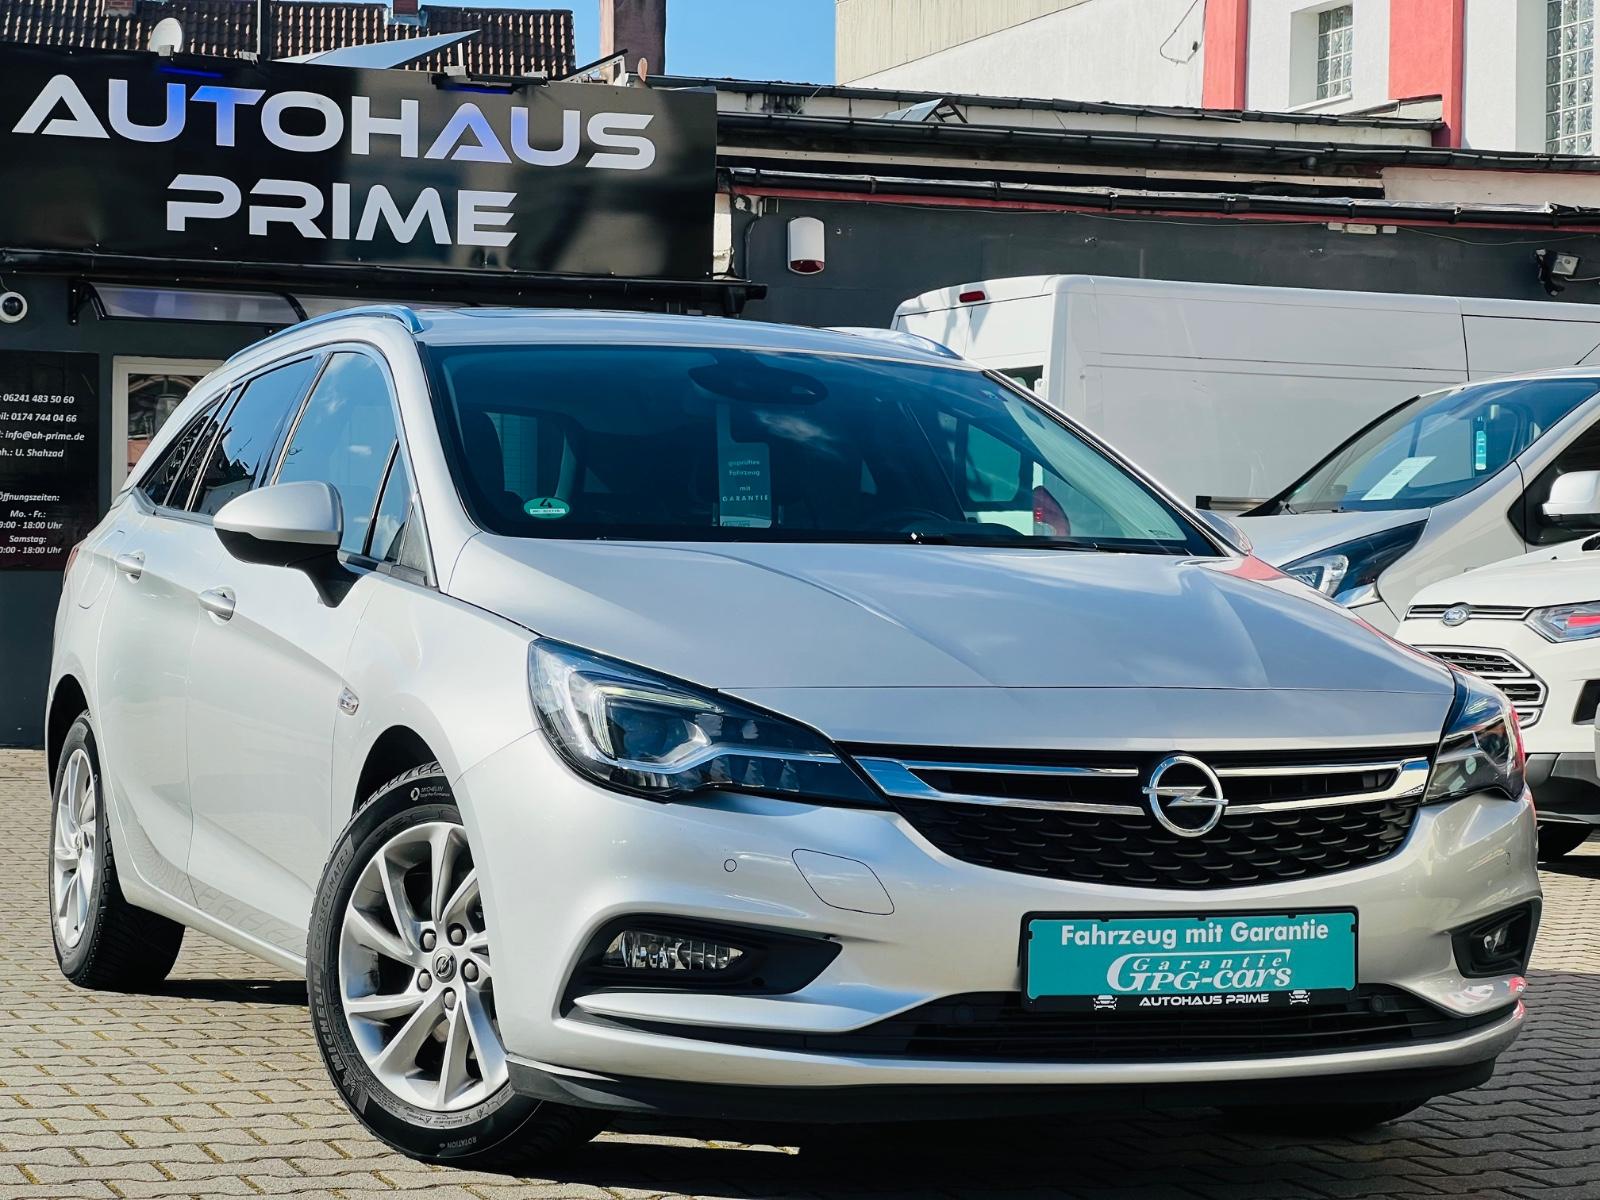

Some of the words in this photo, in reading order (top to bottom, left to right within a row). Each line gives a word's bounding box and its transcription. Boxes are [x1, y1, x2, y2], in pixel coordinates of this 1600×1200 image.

[12, 74, 656, 170] AUTOHAUS
[167, 174, 517, 247] PRIME
[3, 393, 30, 402] 06241
[32, 394, 49, 403] 483
[50, 395, 62, 403] 50
[63, 396, 75, 404] 60
[10, 412, 33, 421] 0174
[35, 413, 51, 421] 744
[53, 414, 64, 422] 04
[66, 414, 77, 422] 66
[5, 430, 85, 441] info@ah-prime.de
[15, 448, 24, 457] U.
[27, 448, 64, 457] Shahzad
[540, 498, 552, 508] 4
[10, 510, 26, 518] Mo.
[33, 510, 47, 518] Fr.:
[22, 521, 46, 529] 18:00
[47, 521, 63, 529] Uhr
[9, 535, 47, 545] Samstag:
[22, 546, 46, 554] 18:00
[47, 546, 62, 554] Uhr
[1061, 923, 1177, 949] Fahrzeug
[1186, 921, 1223, 944] mit
[1230, 919, 1329, 942] Garantie
[1133, 954, 1283, 971] Garantie
[1106, 952, 1292, 992] GPG-cars
[1139, 995, 1223, 1007] AUTOHAUS
[1226, 993, 1270, 1005] PRIME
[312, 968, 345, 1071] MICHELIN
